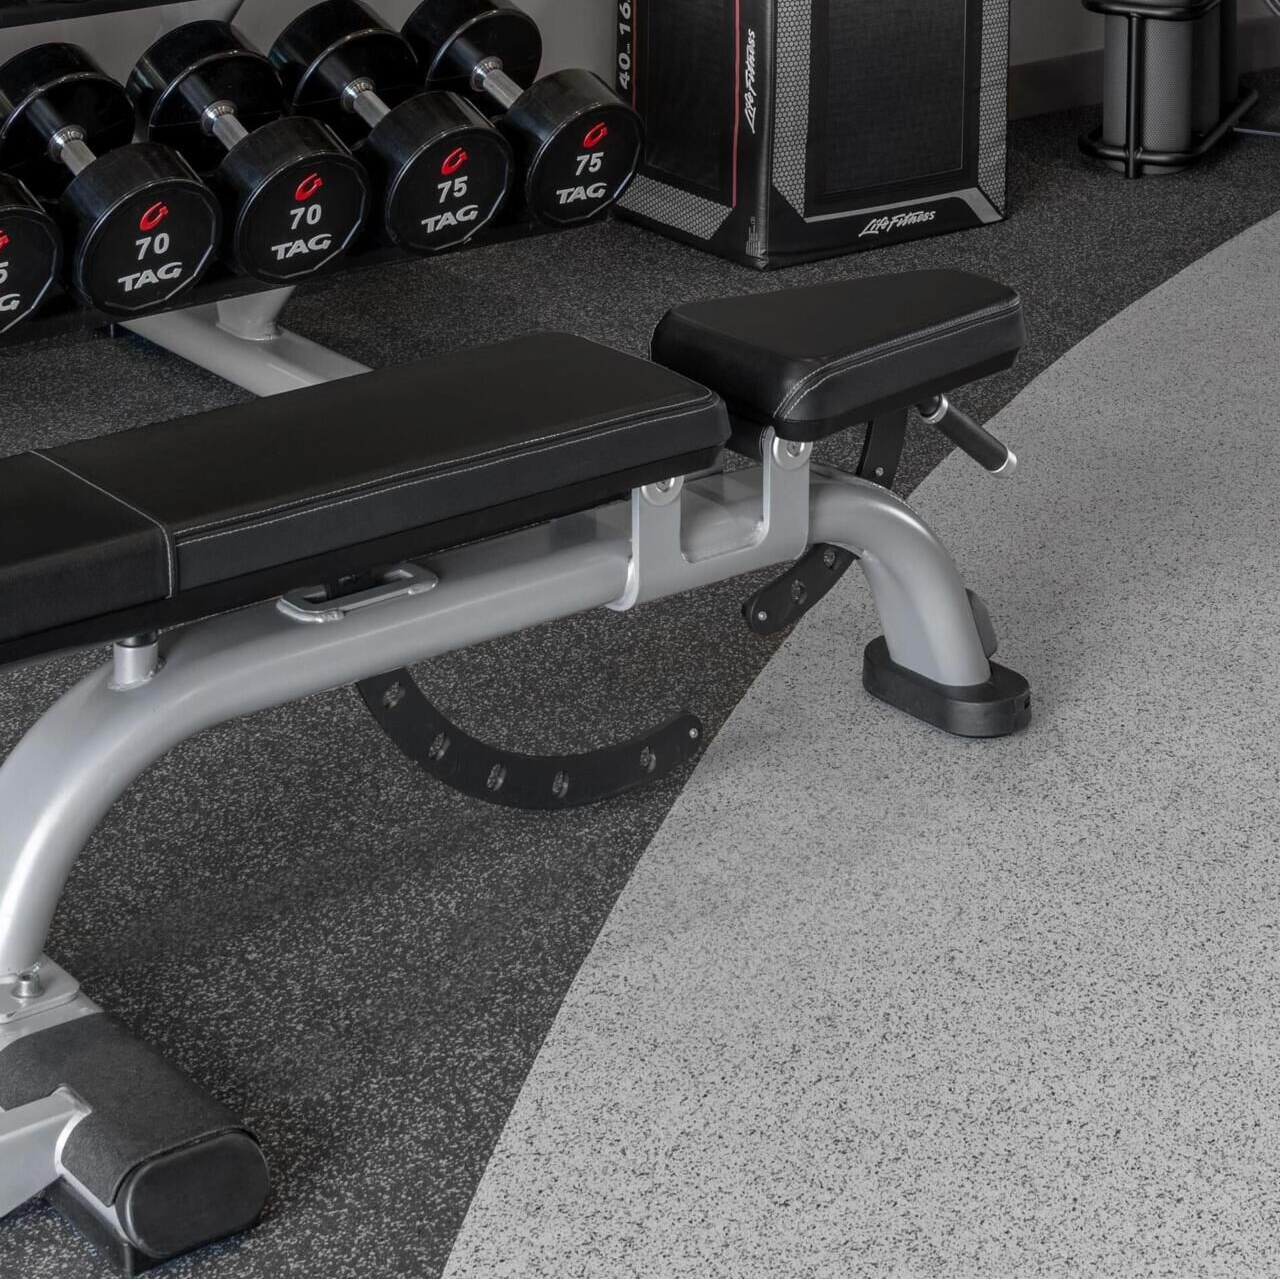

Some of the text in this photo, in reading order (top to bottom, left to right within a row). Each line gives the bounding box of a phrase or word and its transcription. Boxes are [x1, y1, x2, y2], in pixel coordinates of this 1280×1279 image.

[575, 151, 605, 176] 75
[437, 175, 468, 204] 75
[556, 182, 608, 205] TAG
[289, 203, 322, 230] 70
[420, 204, 479, 234] TAG
[135, 232, 170, 261] 70
[271, 233, 332, 261] TAG
[117, 261, 183, 292] TAG
